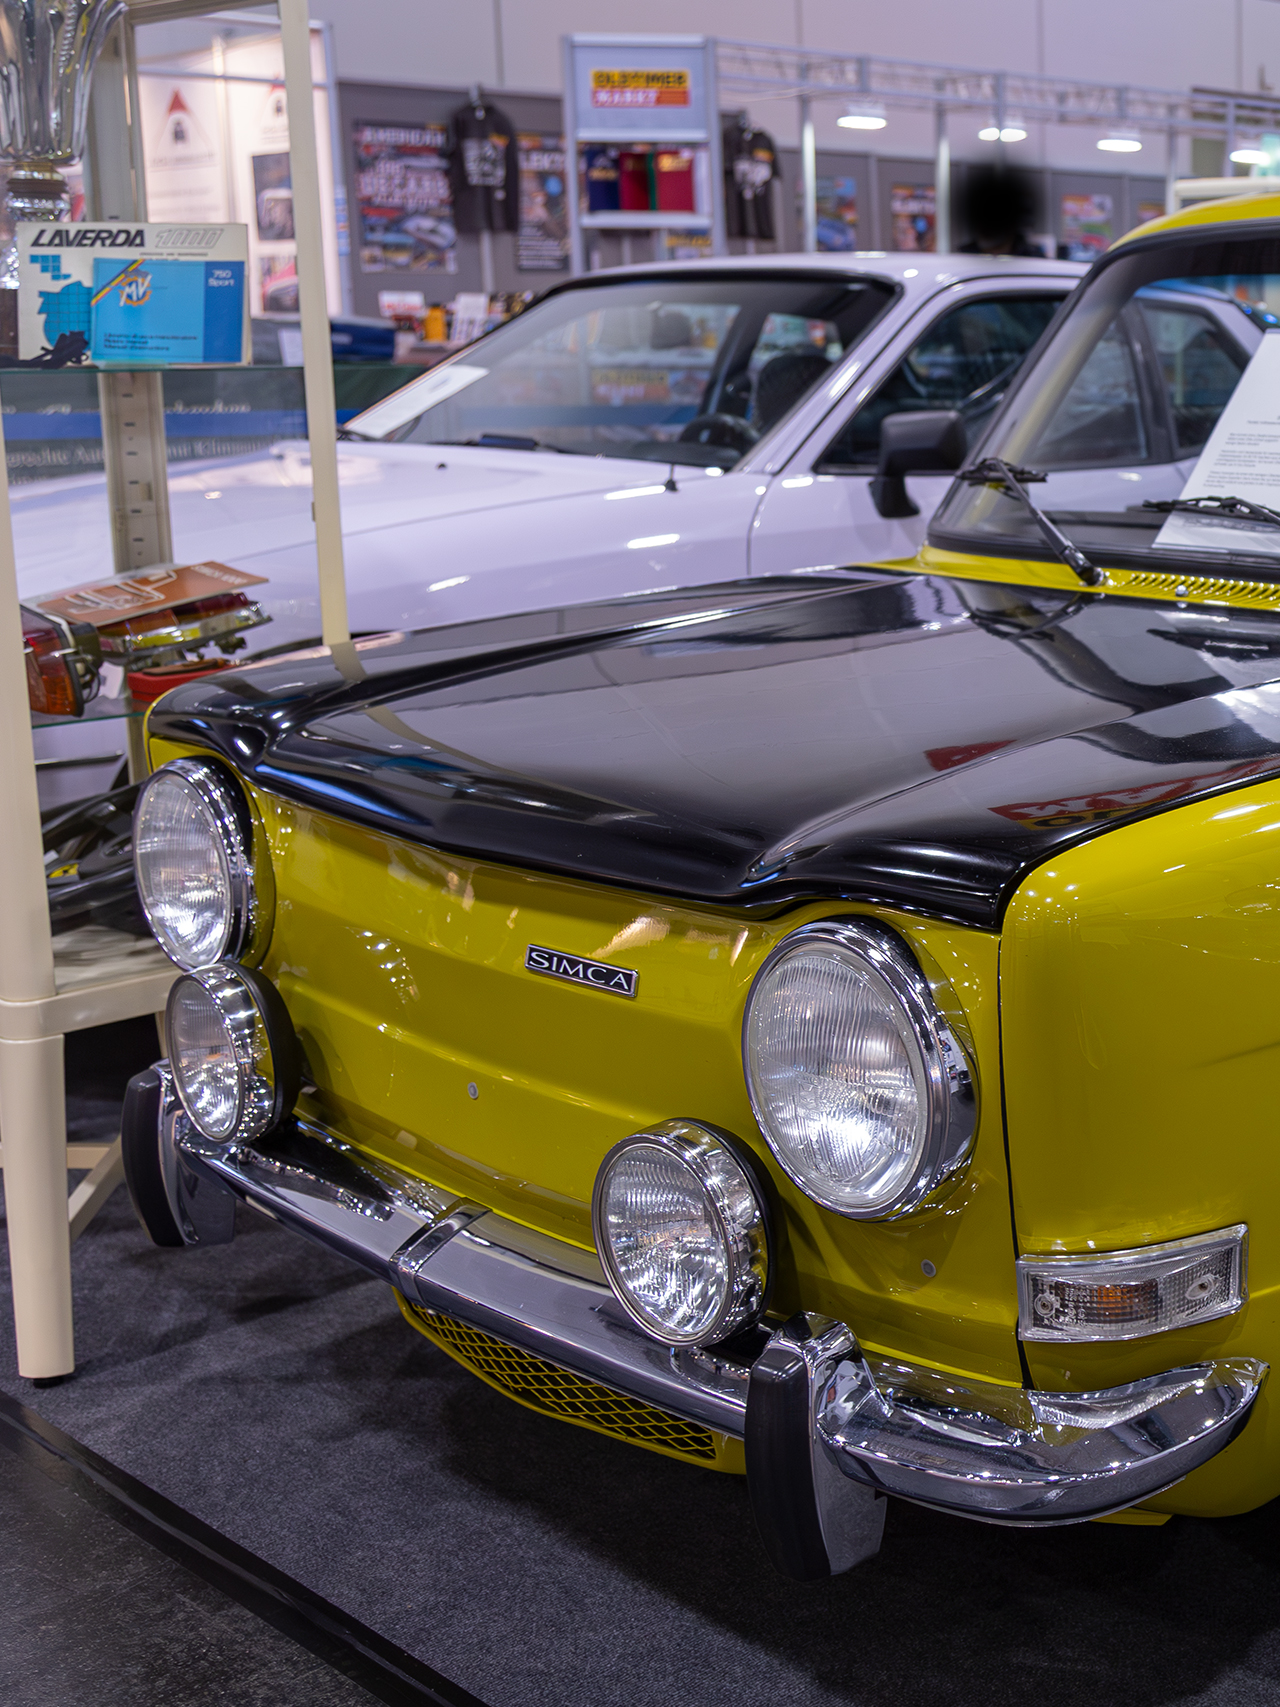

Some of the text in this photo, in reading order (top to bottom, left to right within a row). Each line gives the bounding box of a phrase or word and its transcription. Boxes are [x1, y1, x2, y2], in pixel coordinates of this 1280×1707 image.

[30, 228, 225, 249] LAVERDA 1000
[212, 269, 232, 279] 750
[119, 273, 153, 307] MV
[529, 951, 629, 990] SIMCA
